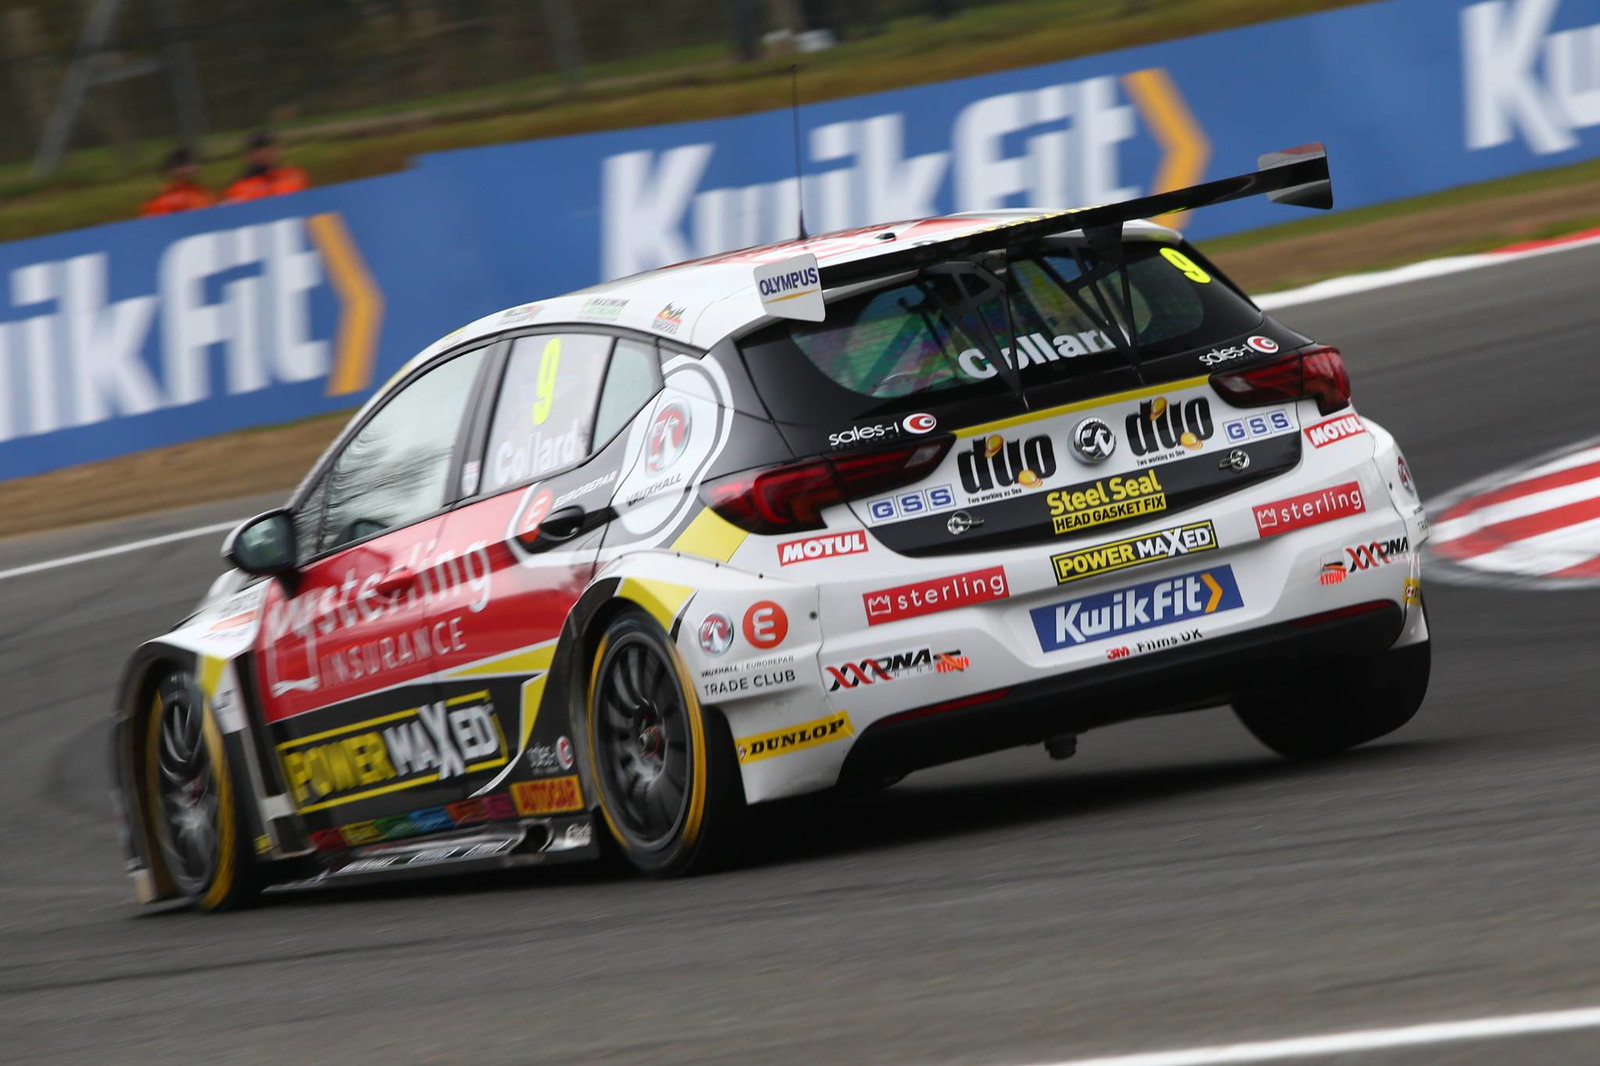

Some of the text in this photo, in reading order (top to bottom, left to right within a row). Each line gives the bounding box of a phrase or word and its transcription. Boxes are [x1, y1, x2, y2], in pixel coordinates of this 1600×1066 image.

[759, 267, 819, 297] OLYMPUS
[1159, 247, 1212, 284] 9
[532, 337, 562, 426] 9
[1125, 397, 1215, 456] duo
[1226, 412, 1290, 441] GSS
[1309, 415, 1364, 447] MOTUL
[957, 433, 1057, 494] duo
[626, 472, 682, 506] VAUXHALL
[871, 487, 952, 519] GSS
[1046, 469, 1163, 515] Steel Seal
[1281, 489, 1363, 522] sterling
[1055, 495, 1165, 532] HEAD GASKET FIX
[781, 533, 865, 564] MOTUL
[1058, 528, 1212, 578] POWER MAXED
[897, 573, 1005, 611] sterling
[320, 616, 467, 688] INSURANCE
[1136, 637, 1178, 652] Films
[1182, 629, 1204, 642] UK
[700, 664, 739, 678] VAUXHALL
[703, 669, 796, 698] TRADE CLUB
[283, 731, 398, 804] POWER
[384, 701, 499, 781] MAXED
[749, 719, 845, 757] DUNLOP
